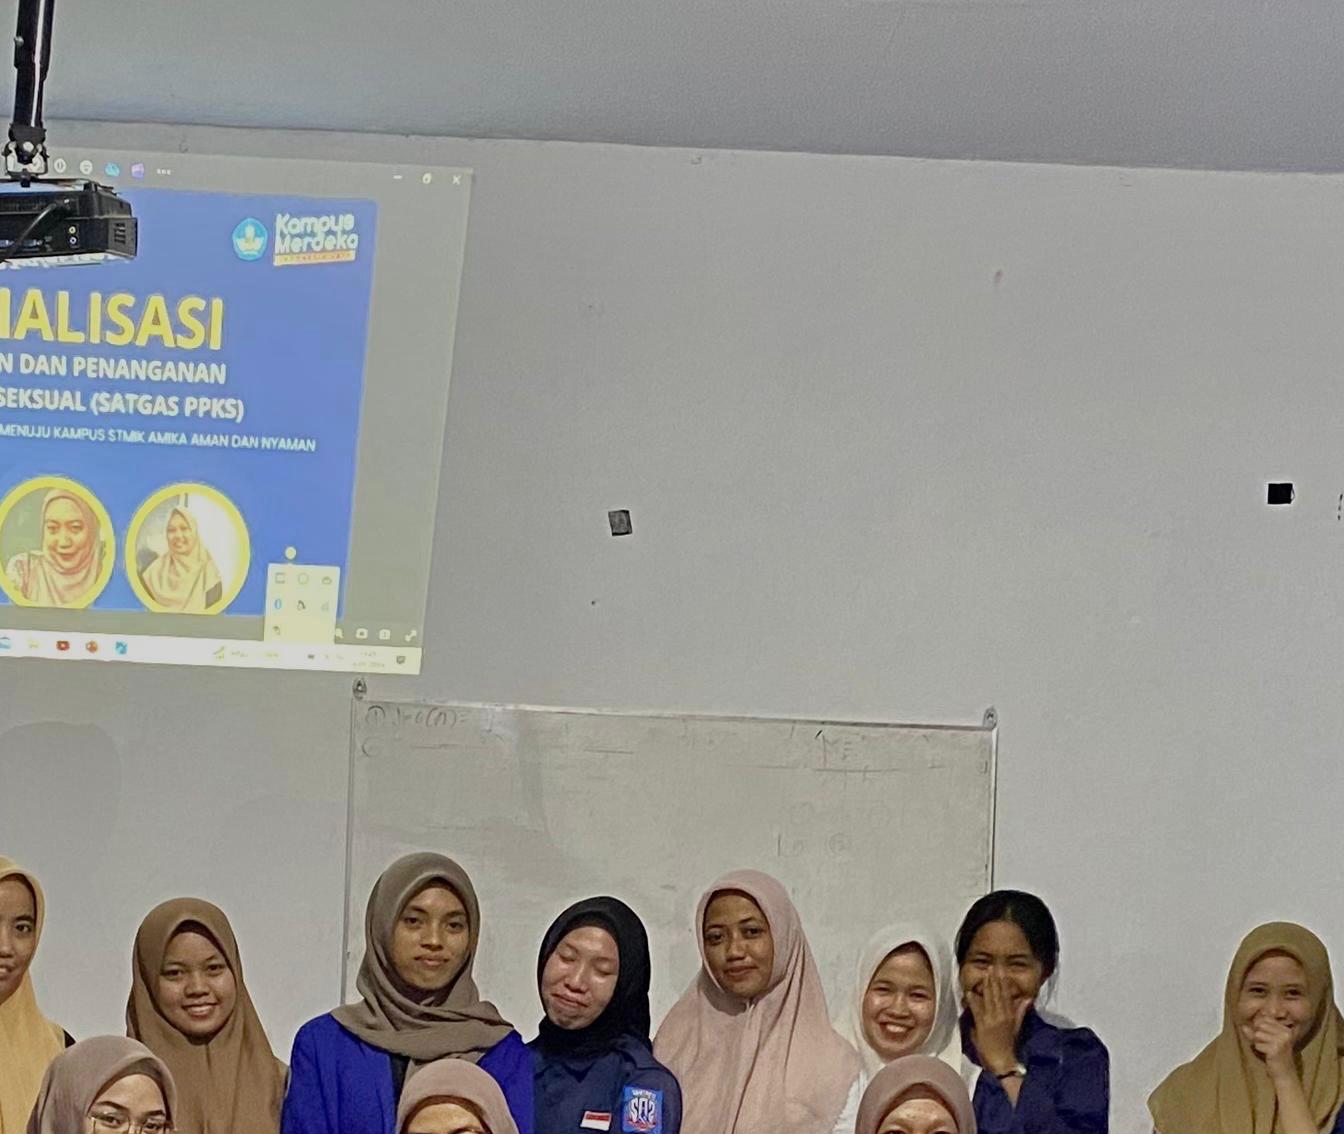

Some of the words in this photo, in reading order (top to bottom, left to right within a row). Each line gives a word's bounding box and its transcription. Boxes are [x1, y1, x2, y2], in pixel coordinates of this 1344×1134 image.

[275, 231, 358, 254] Merdeka
[20, 352, 67, 377] DAN
[72, 355, 227, 385] PENANGANAN
[90, 391, 180, 417] (SATGAS
[184, 396, 245, 424] PPKS)
[53, 425, 105, 442] KAMPUS
[107, 428, 145, 443] STMIK
[147, 430, 188, 446] AMIKA
[190, 432, 229, 448] AMAN
[231, 434, 259, 450] DAN
[260, 436, 317, 452] NYAMAN
